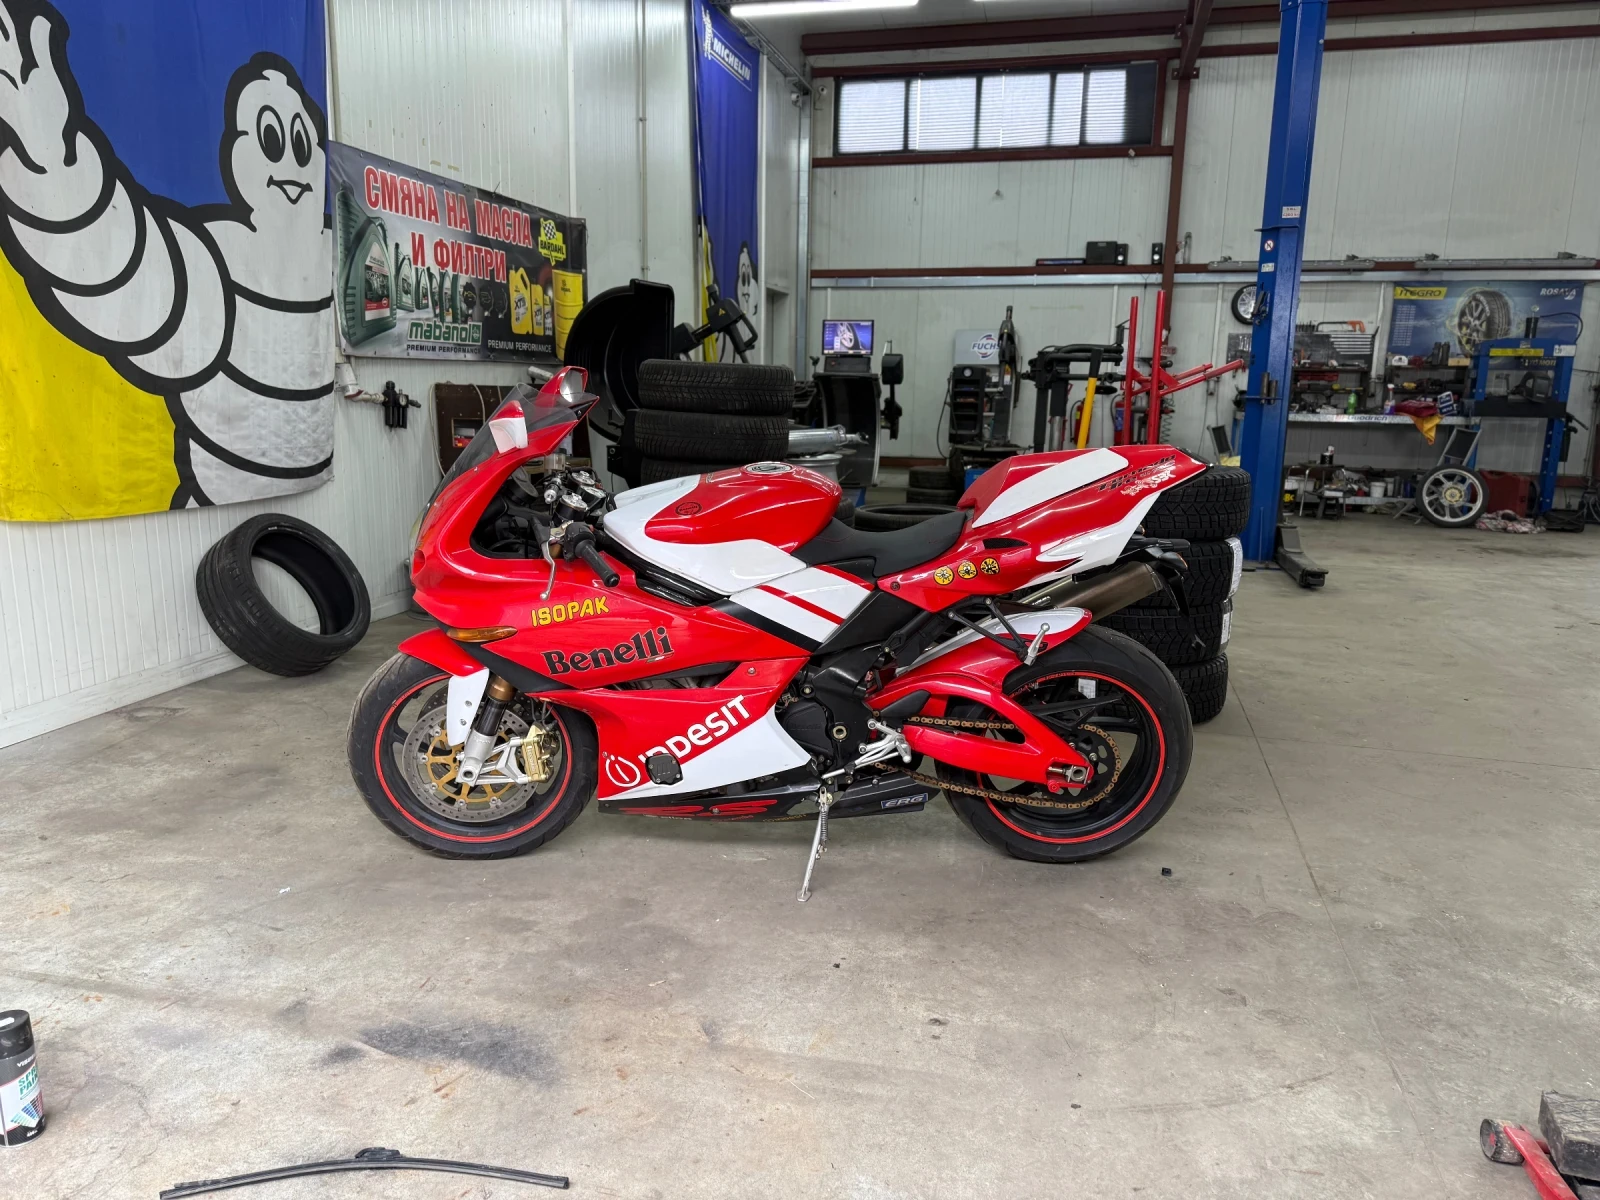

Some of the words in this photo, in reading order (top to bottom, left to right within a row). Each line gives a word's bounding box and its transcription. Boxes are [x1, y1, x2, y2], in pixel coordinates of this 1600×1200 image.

[713, 37, 751, 81] MICHELIN
[364, 166, 440, 225] СМЯНА
[444, 191, 471, 233] НА
[474, 198, 533, 249] МАСЛА
[411, 231, 427, 268] И
[433, 238, 507, 283] ФИЛТРИ
[540, 239, 565, 255] BARDAHL
[1540, 287, 1577, 299] ROSAVA
[408, 320, 471, 342] mabanol
[406, 344, 437, 352] PREMIUM
[438, 345, 481, 354] PERFORMANCE
[487, 339, 514, 350] PREMIUM
[515, 341, 552, 353] PERFORMANCE
[531, 596, 610, 627] ISOPAK
[541, 626, 674, 675] Benelli
